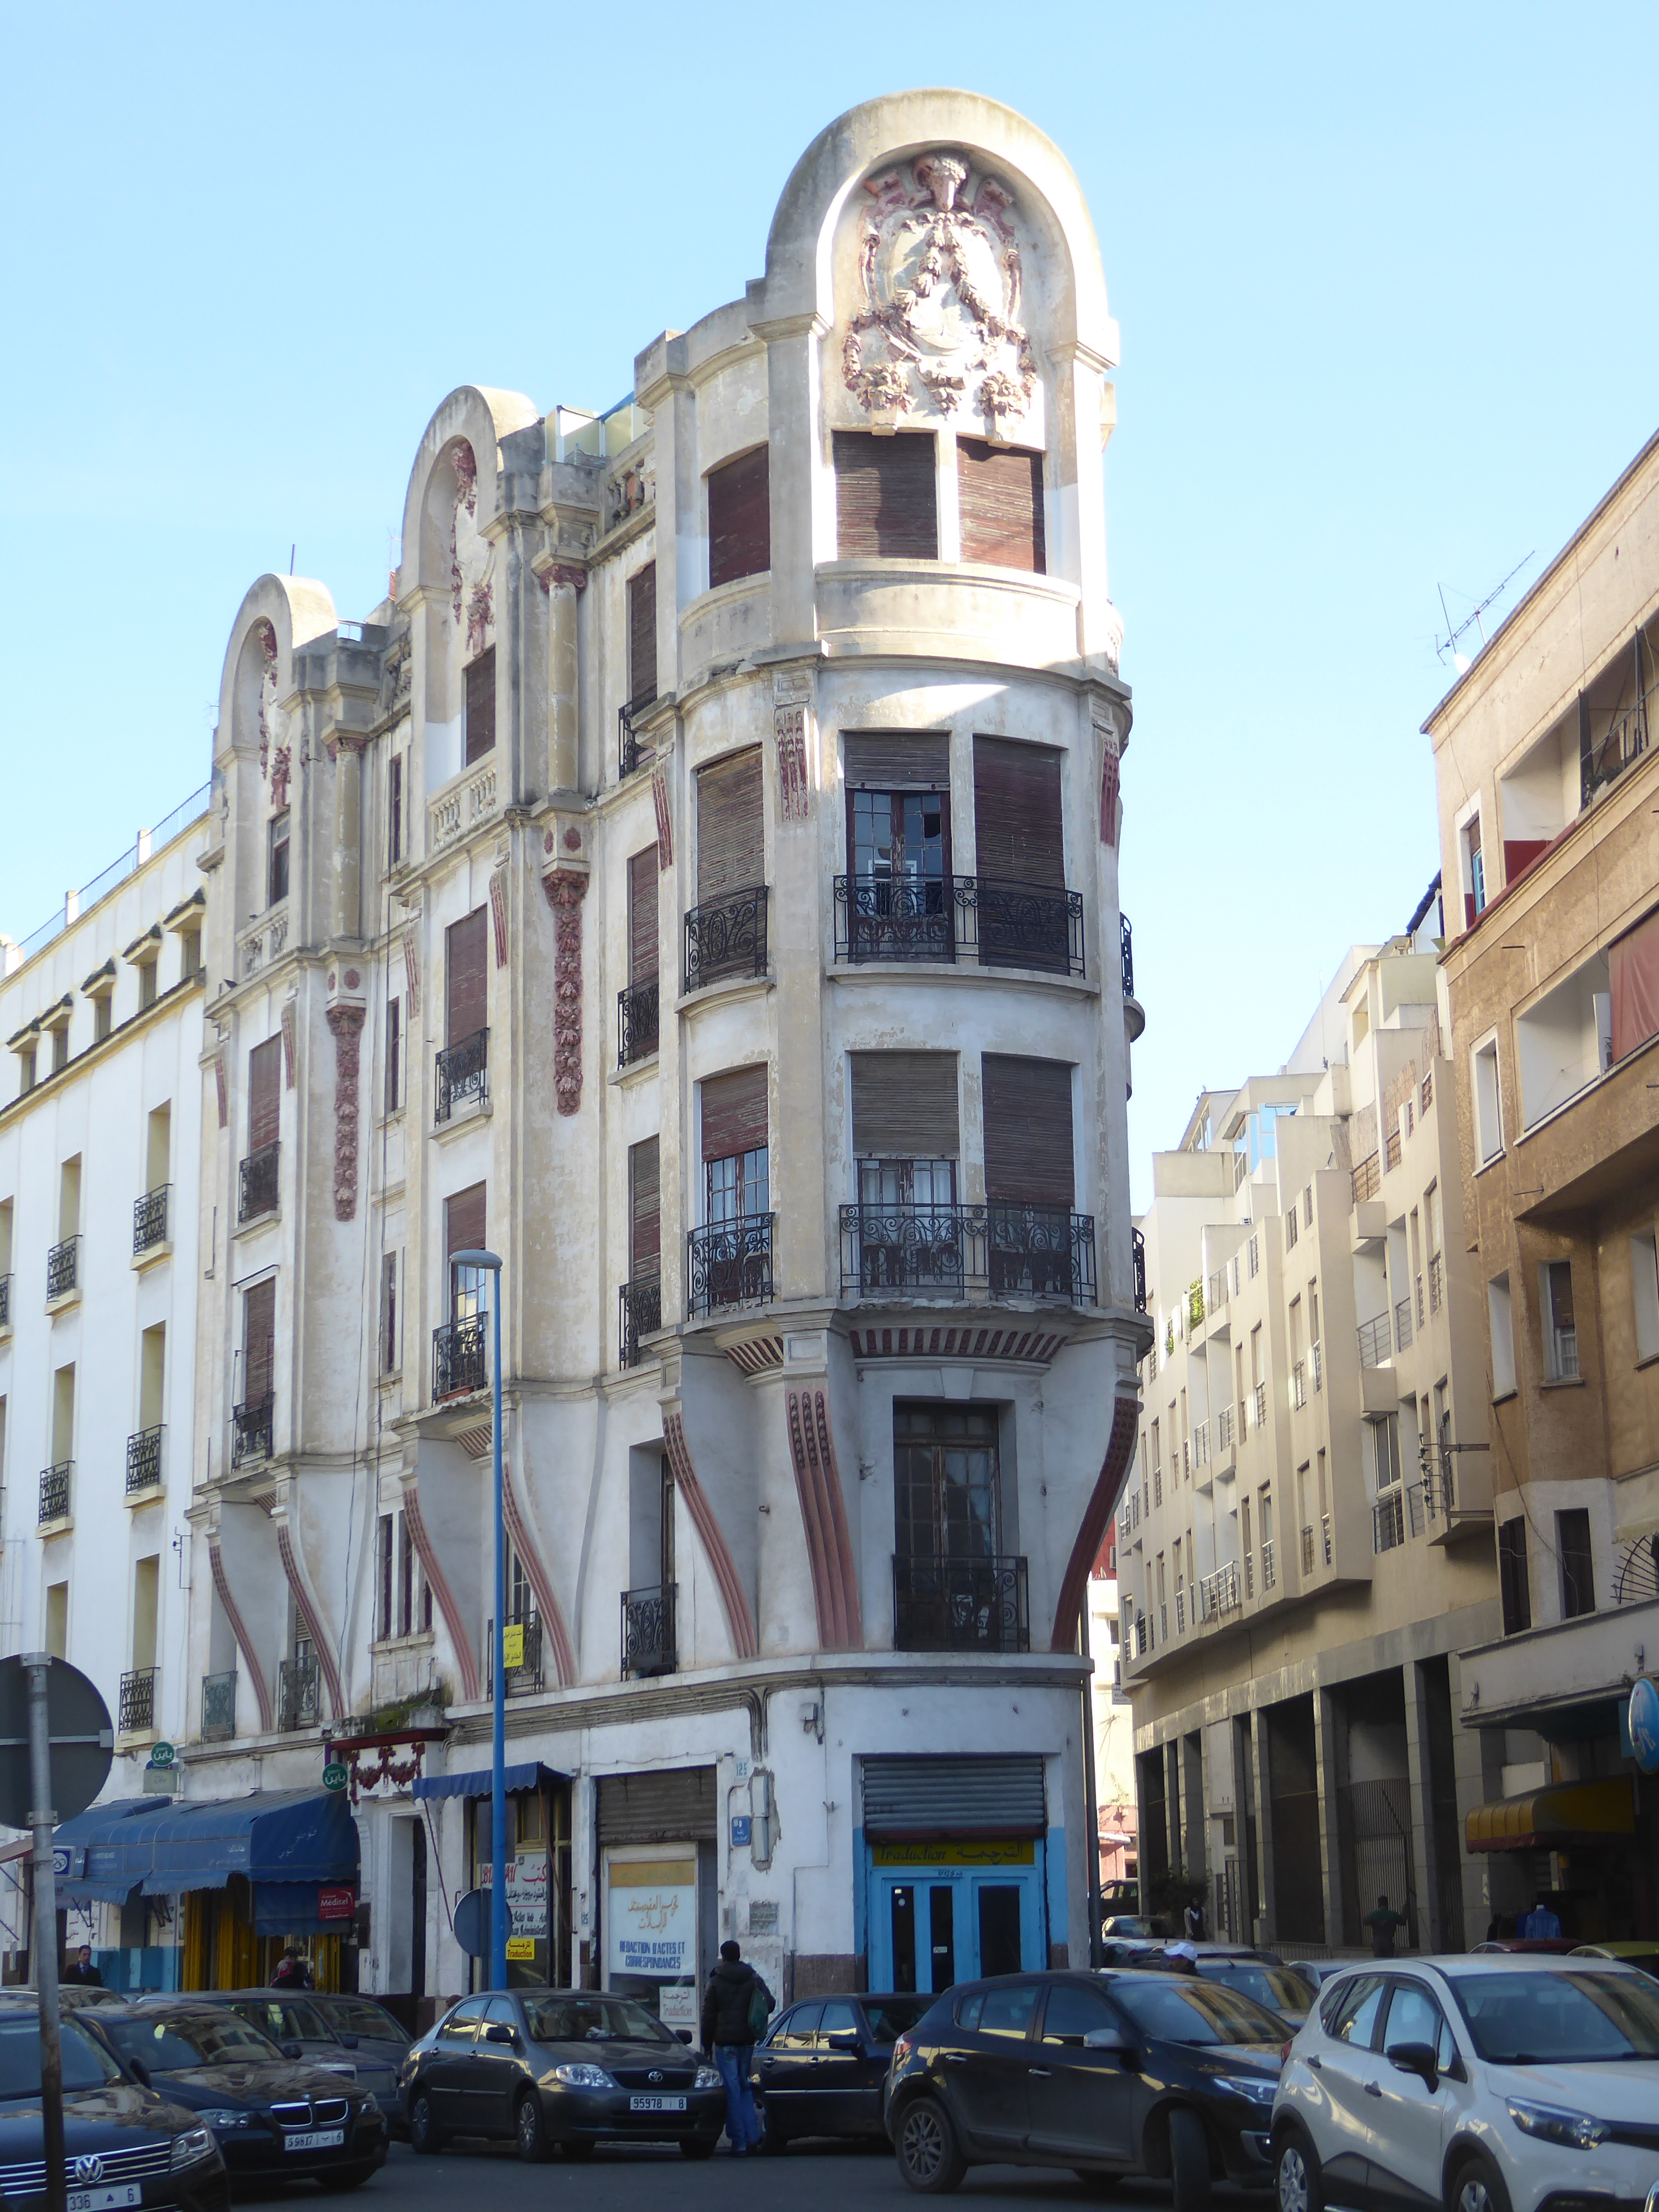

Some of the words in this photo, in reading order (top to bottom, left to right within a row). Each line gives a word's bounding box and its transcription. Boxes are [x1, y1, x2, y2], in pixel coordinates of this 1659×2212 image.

[736, 1762, 747, 1776] 125
[321, 1897, 348, 1907] Méditel
[619, 1940, 651, 1954] REDACTION
[653, 1942, 676, 1954] D'ACTES
[678, 1942, 685, 1954] ET
[507, 1949, 532, 1958] Traduction
[625, 1955, 681, 1969] CORRESPONDANCES
[663, 2004, 692, 2016] Traduction
[634, 2098, 662, 2109] 95978
[679, 2099, 684, 2109] 8
[288, 2135, 314, 2147] 59817
[70, 2194, 91, 2211] 336
[127, 2188, 134, 2202] 6
